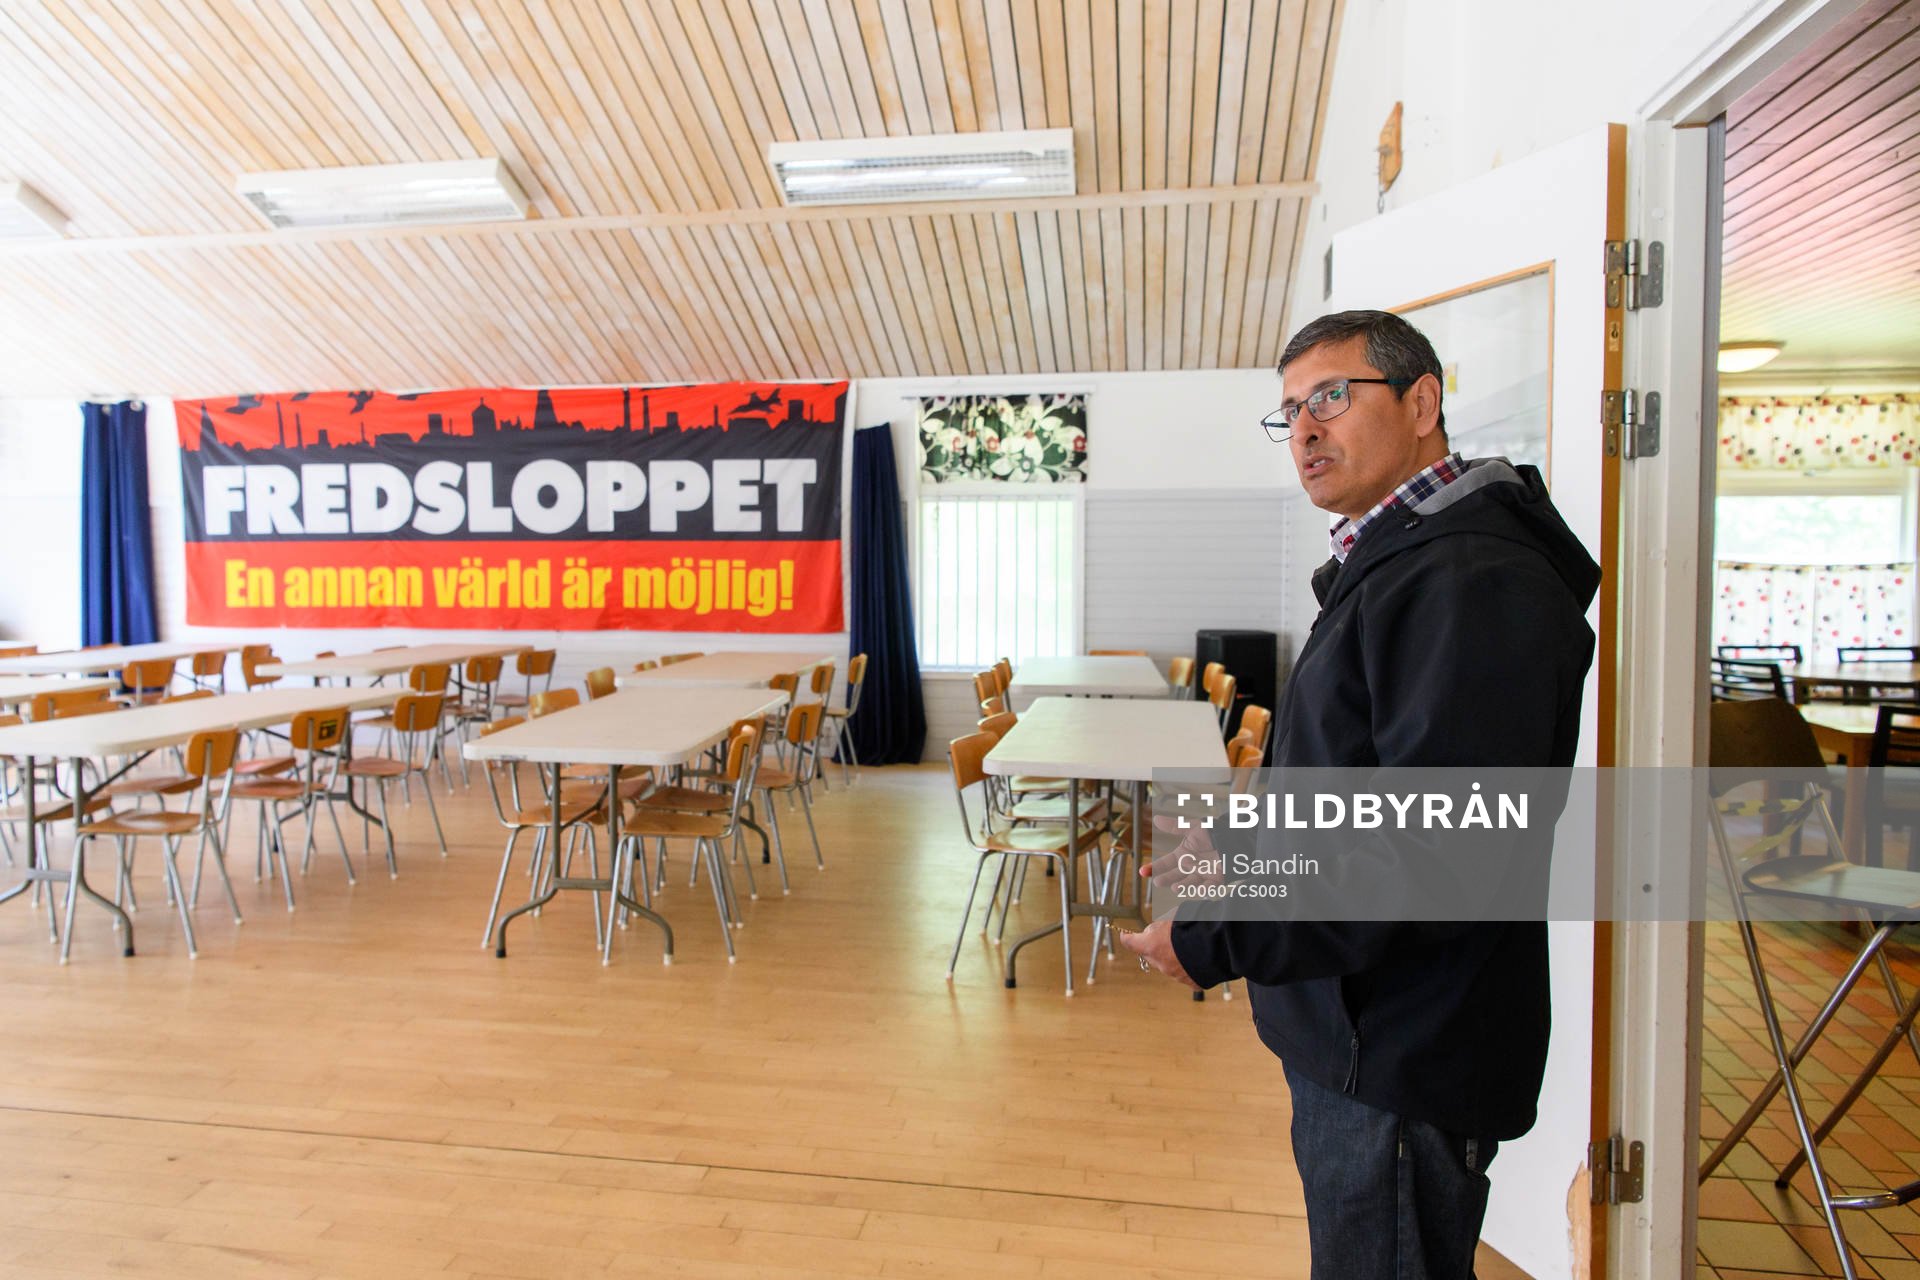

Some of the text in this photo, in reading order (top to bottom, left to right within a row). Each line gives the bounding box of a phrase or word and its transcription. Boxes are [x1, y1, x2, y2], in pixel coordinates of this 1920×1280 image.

[202, 458, 818, 536] FREDSLOPPET
[225, 556, 795, 617] En annan värld är möjlig!
